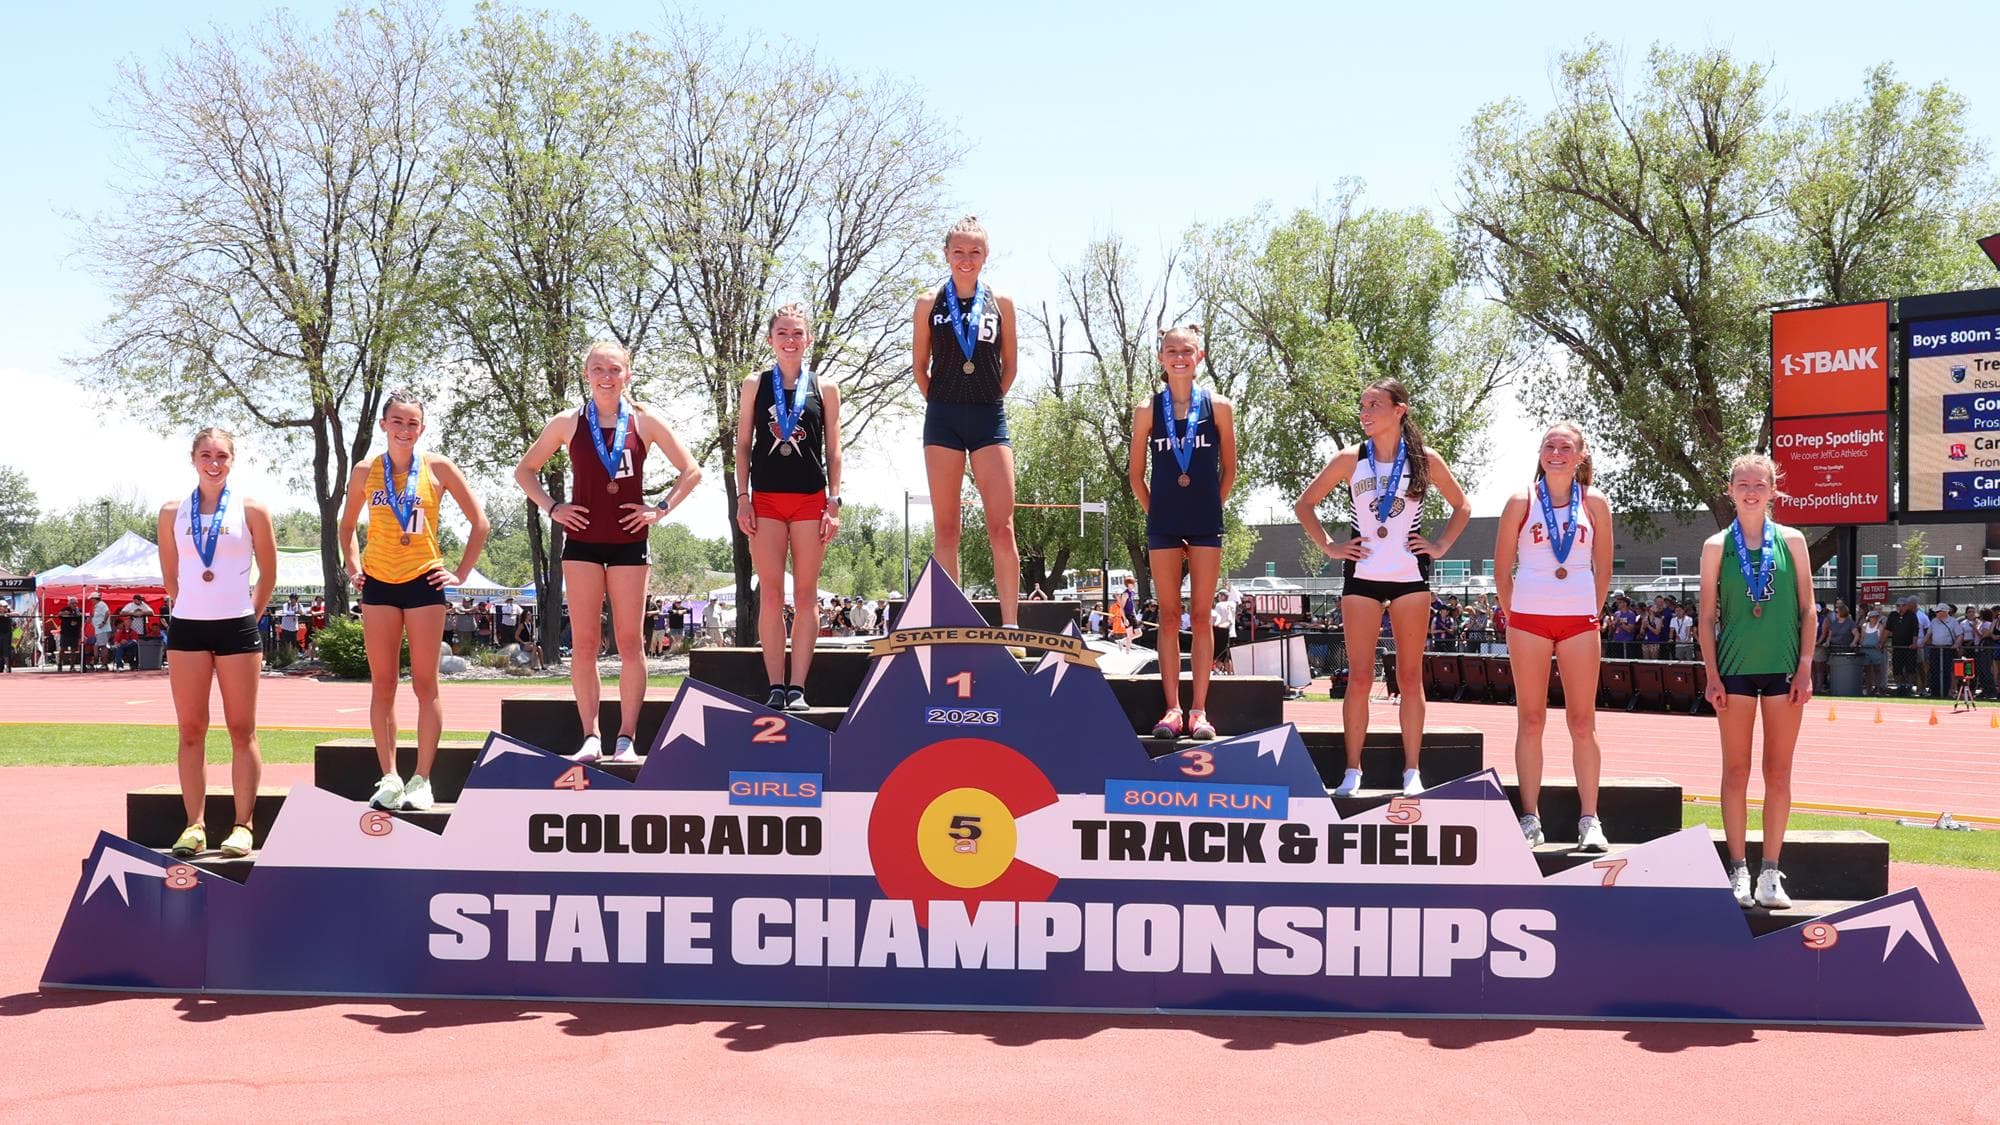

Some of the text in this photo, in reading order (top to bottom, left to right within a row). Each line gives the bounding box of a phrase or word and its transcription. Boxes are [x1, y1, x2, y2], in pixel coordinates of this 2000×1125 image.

[983, 317, 994, 340] 5
[1913, 333, 1947, 349] Boys
[1950, 329, 1991, 344] 800m
[1974, 358, 2000, 371] Tre
[1974, 417, 2000, 429] Pros
[1776, 429, 1884, 449] CO Prep Spotlight
[1790, 451, 1801, 461] We
[1802, 452, 1819, 460] cover
[1840, 448, 1868, 459] Athletics
[1974, 457, 2000, 468] Fron
[1781, 491, 1878, 509] PrepSpotlight.tv
[1530, 522, 1588, 544] ET
[5, 579, 23, 587] 1977
[1258, 595, 1289, 612] 110
[895, 630, 1076, 650] STATE CHAMPION
[945, 670, 974, 699] 1
[927, 709, 999, 725] 2026
[751, 715, 790, 744] 2
[1179, 749, 1216, 778] 3
[553, 765, 592, 791] 4
[730, 781, 817, 798] GIRLS
[1124, 790, 1273, 810] 800M RUN
[1386, 797, 1422, 825] 5
[359, 811, 394, 837] 6
[528, 813, 823, 856] COLORADO
[948, 815, 983, 841] 5
[1072, 819, 1478, 866] TRACK & FIELD
[164, 863, 199, 891] 8
[1592, 857, 1629, 887] 7
[428, 892, 1557, 979] STATE CHAMPIONSHIPS
[1801, 922, 1840, 950] 9
